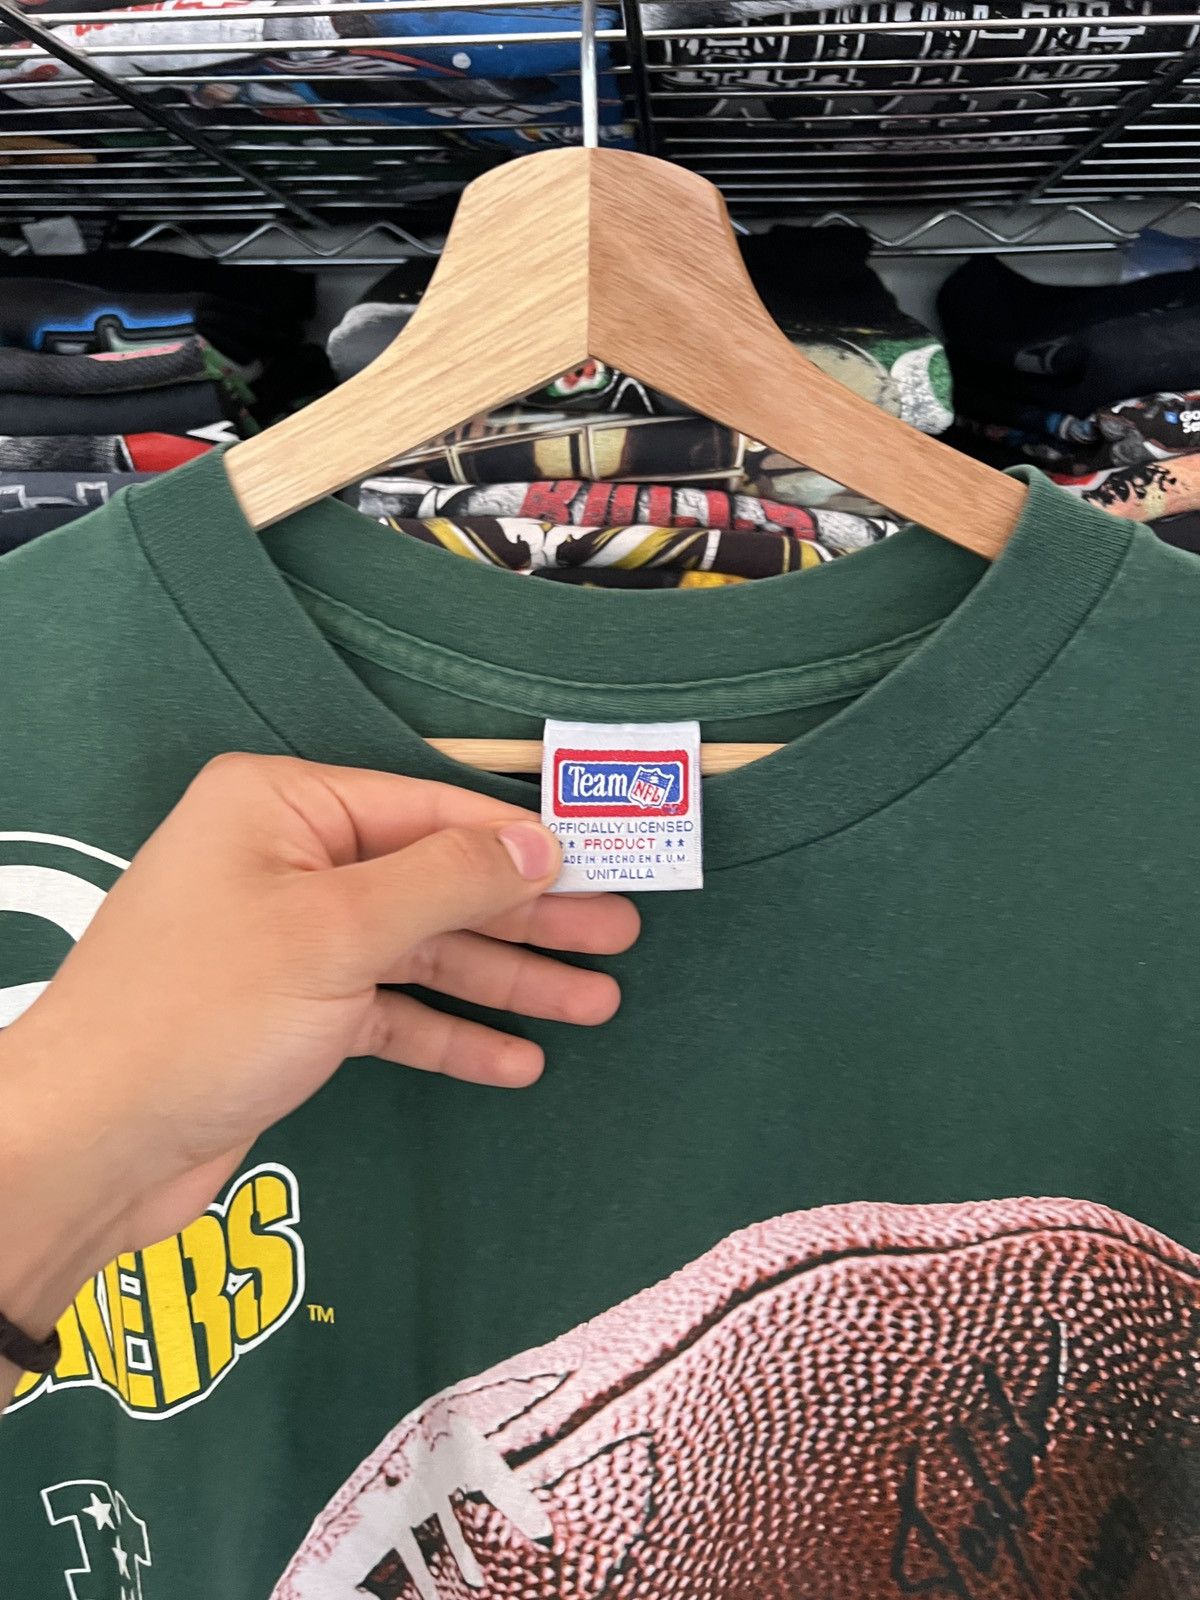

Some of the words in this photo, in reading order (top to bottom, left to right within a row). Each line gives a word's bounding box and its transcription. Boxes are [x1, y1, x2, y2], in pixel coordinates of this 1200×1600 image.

[568, 766, 628, 797] Team
[632, 780, 661, 803] NFL
[549, 822, 623, 834] OFFICIALLY
[627, 820, 694, 833] LICENSED
[584, 838, 656, 850] PRODUCT
[563, 855, 582, 864] ADE
[602, 854, 635, 864] HECHO
[639, 854, 652, 864] EN
[586, 869, 655, 880] UNITALLA
[306, 1304, 335, 1324] TM
